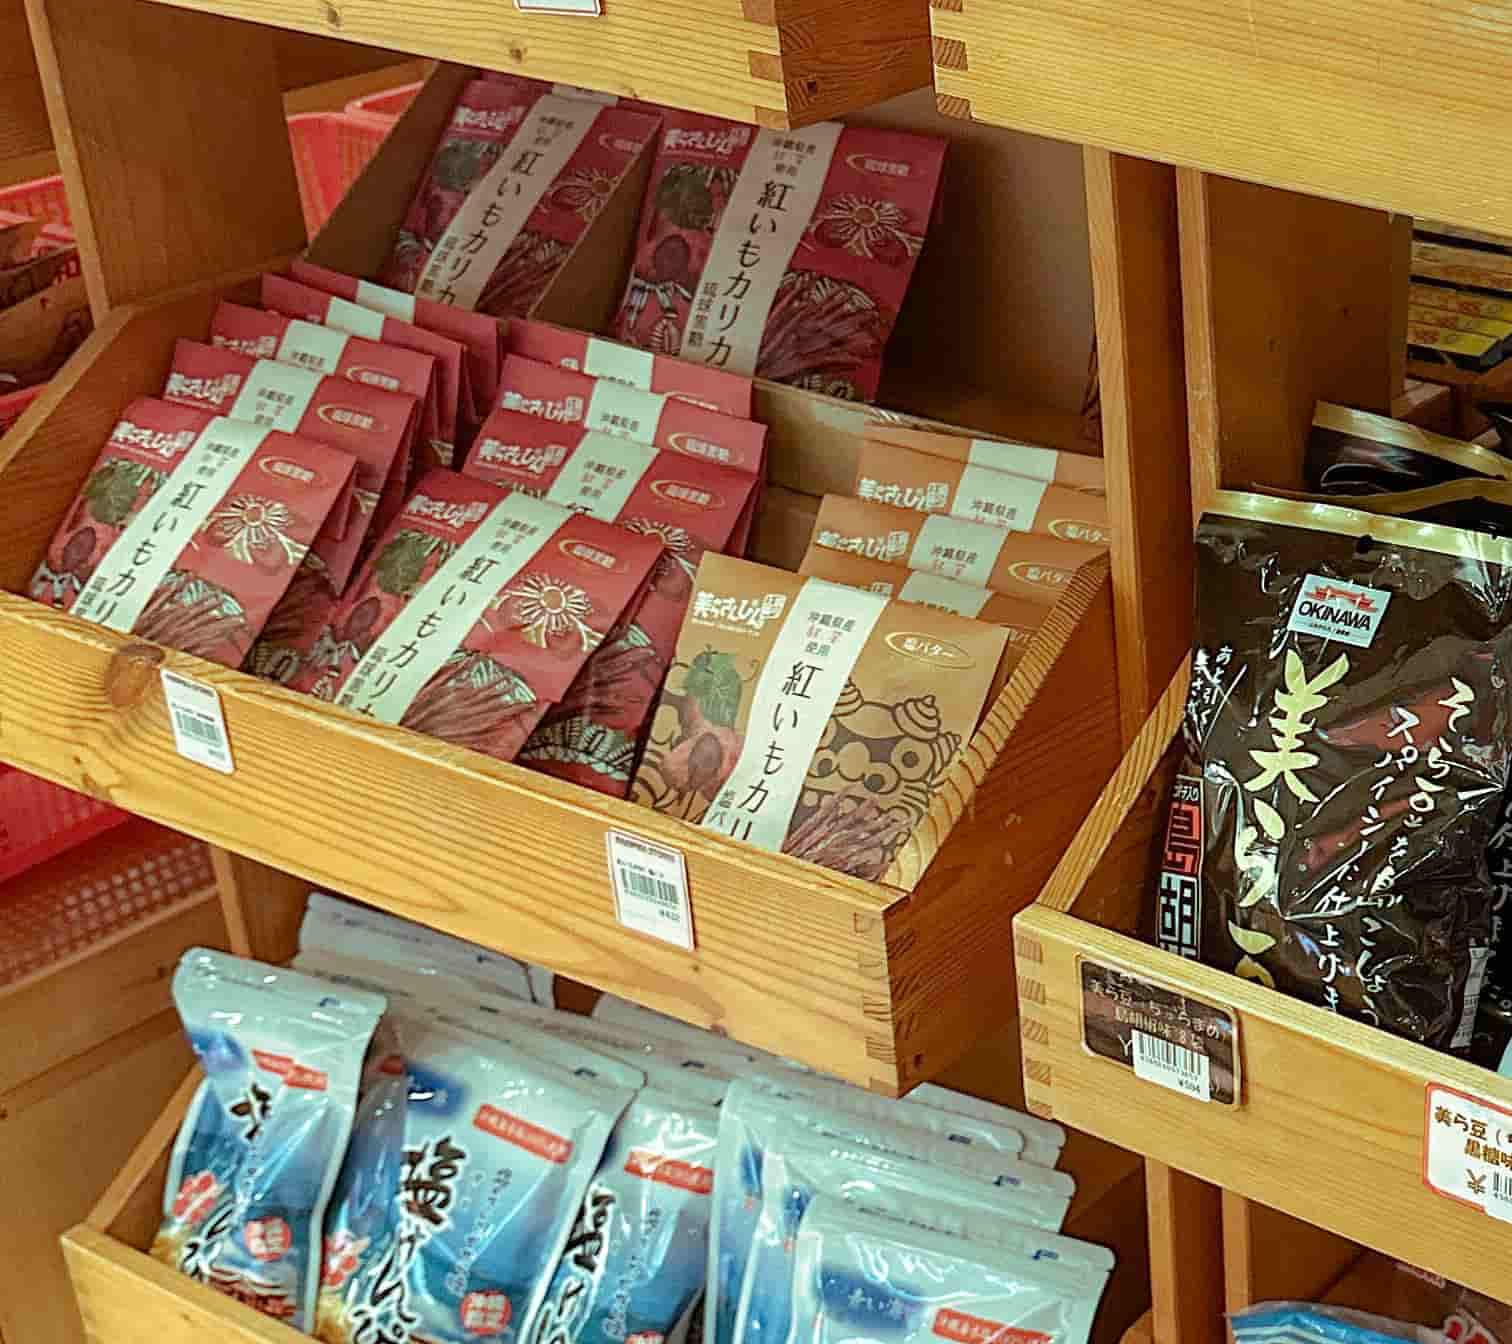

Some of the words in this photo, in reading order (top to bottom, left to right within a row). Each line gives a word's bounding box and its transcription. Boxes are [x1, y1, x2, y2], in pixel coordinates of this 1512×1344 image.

[361, 556, 500, 717] 紅いもカリ
[1298, 599, 1372, 633] OKINAWA
